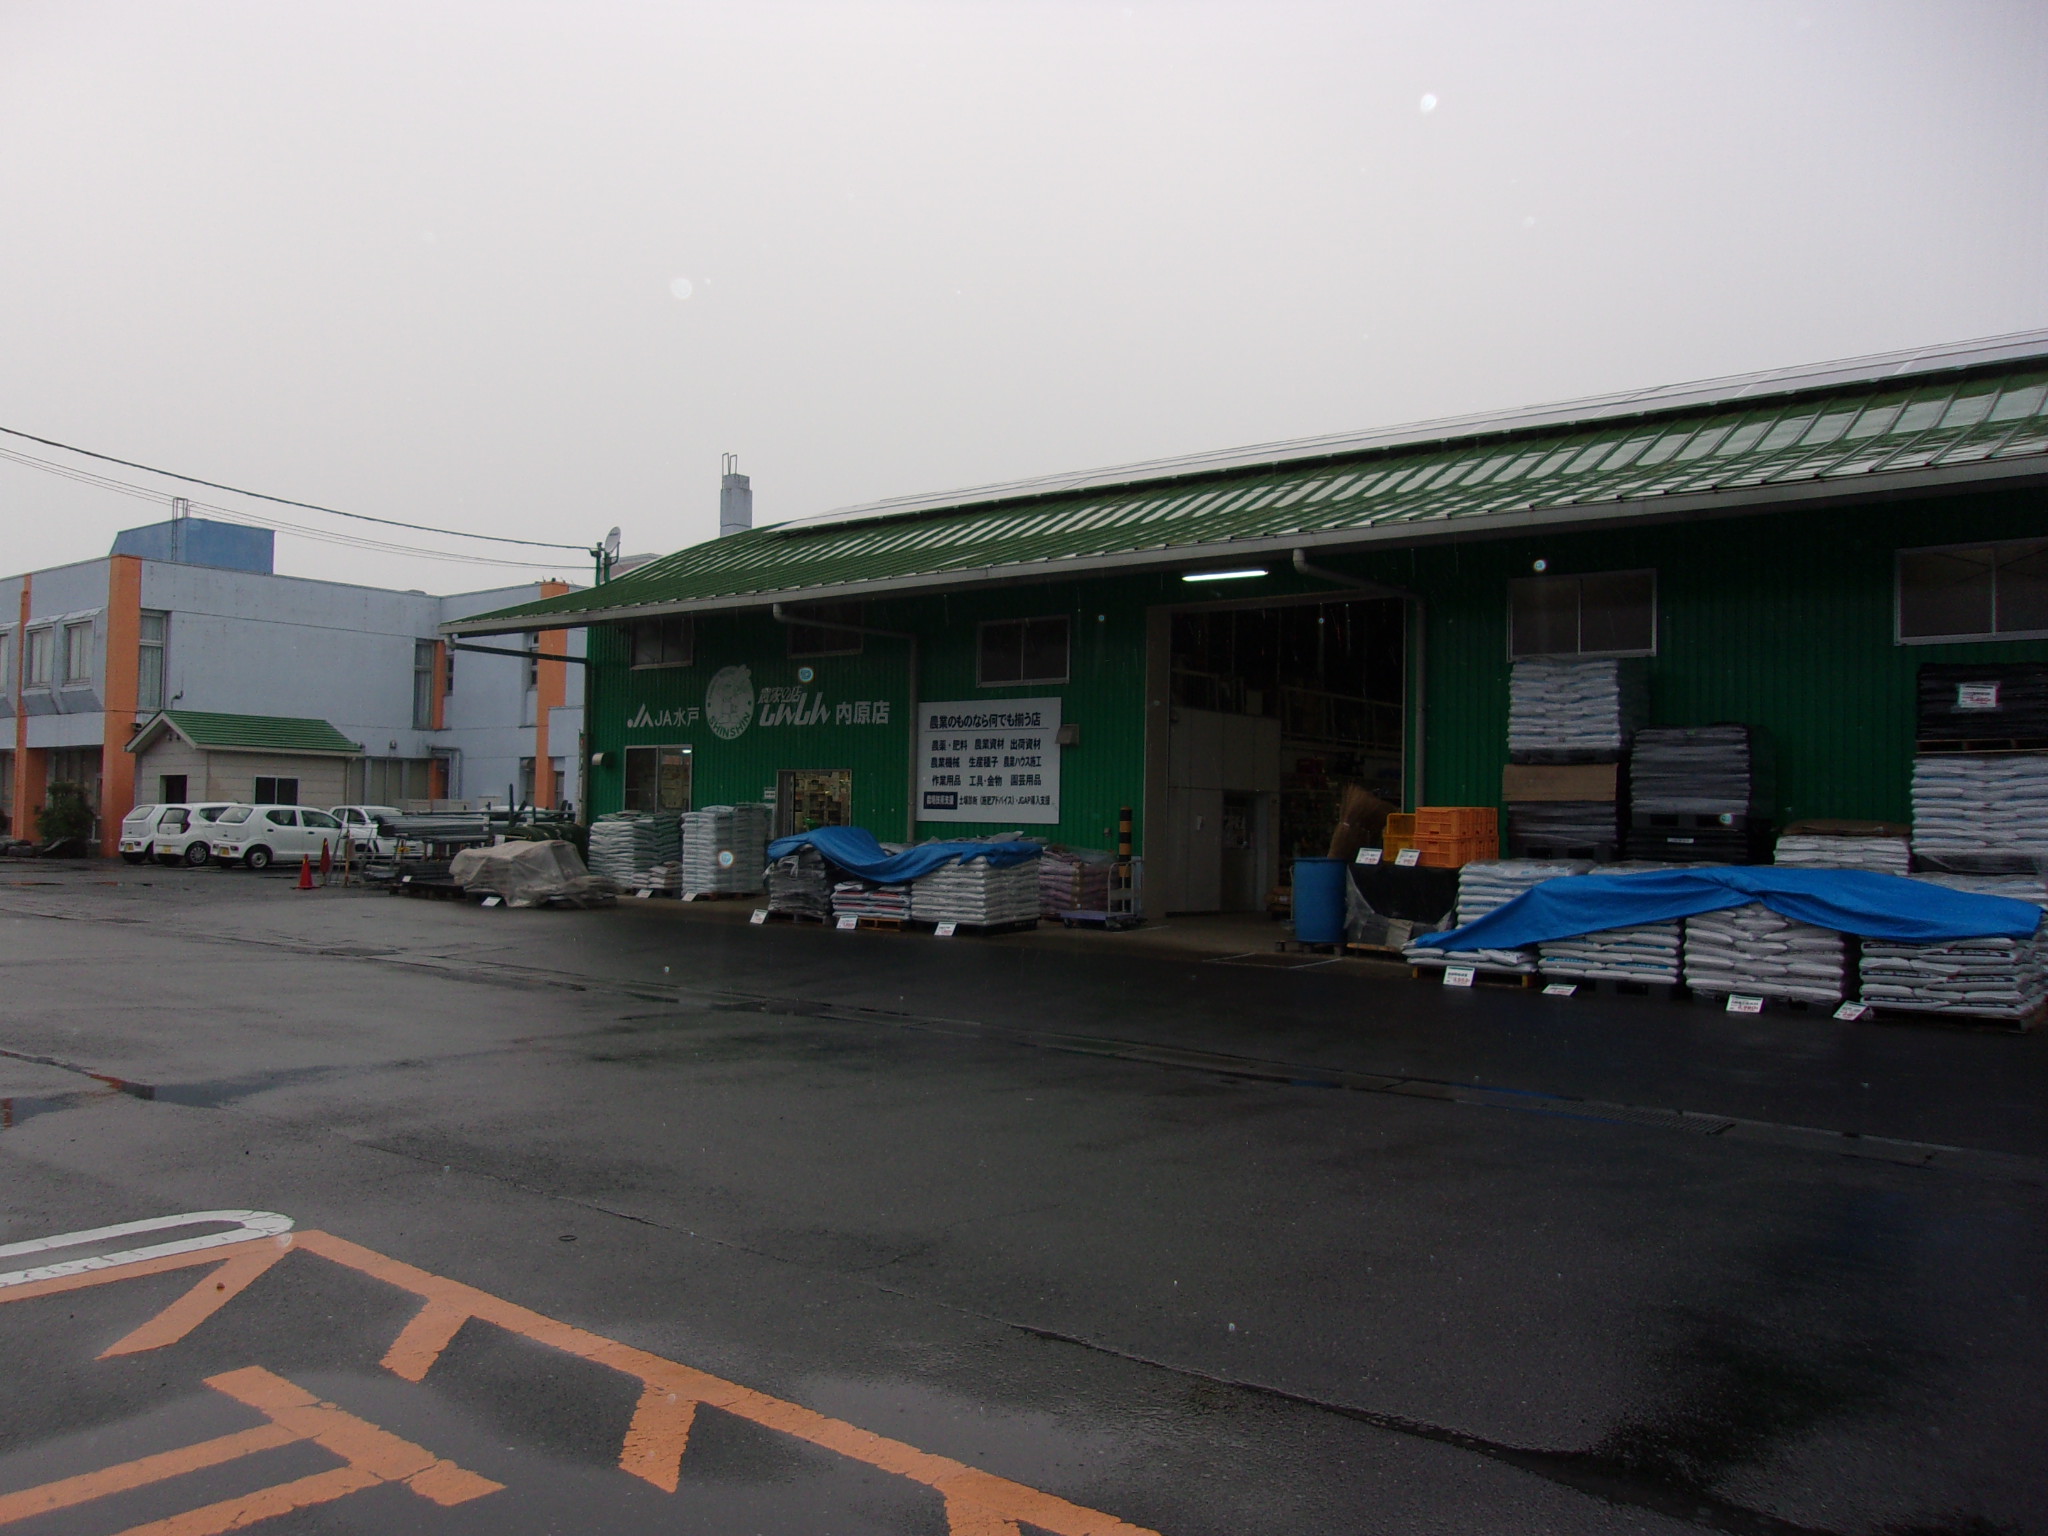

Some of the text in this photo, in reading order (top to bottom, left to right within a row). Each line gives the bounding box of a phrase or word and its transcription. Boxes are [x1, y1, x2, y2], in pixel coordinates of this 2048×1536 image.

[654, 706, 700, 727] JA水戸
[835, 699, 891, 726] 内原店
[929, 711, 1041, 729] 農業のものなら何でも揃う店
[708, 711, 751, 738] SHINSHIN
[931, 738, 1041, 751] 農薬・肥料 農業資材 出荷資材
[930, 755, 1042, 769] 農業機械 生産種子 農業ハウス施工
[932, 774, 1042, 787] 作業用品 工具・金物 園芸用品
